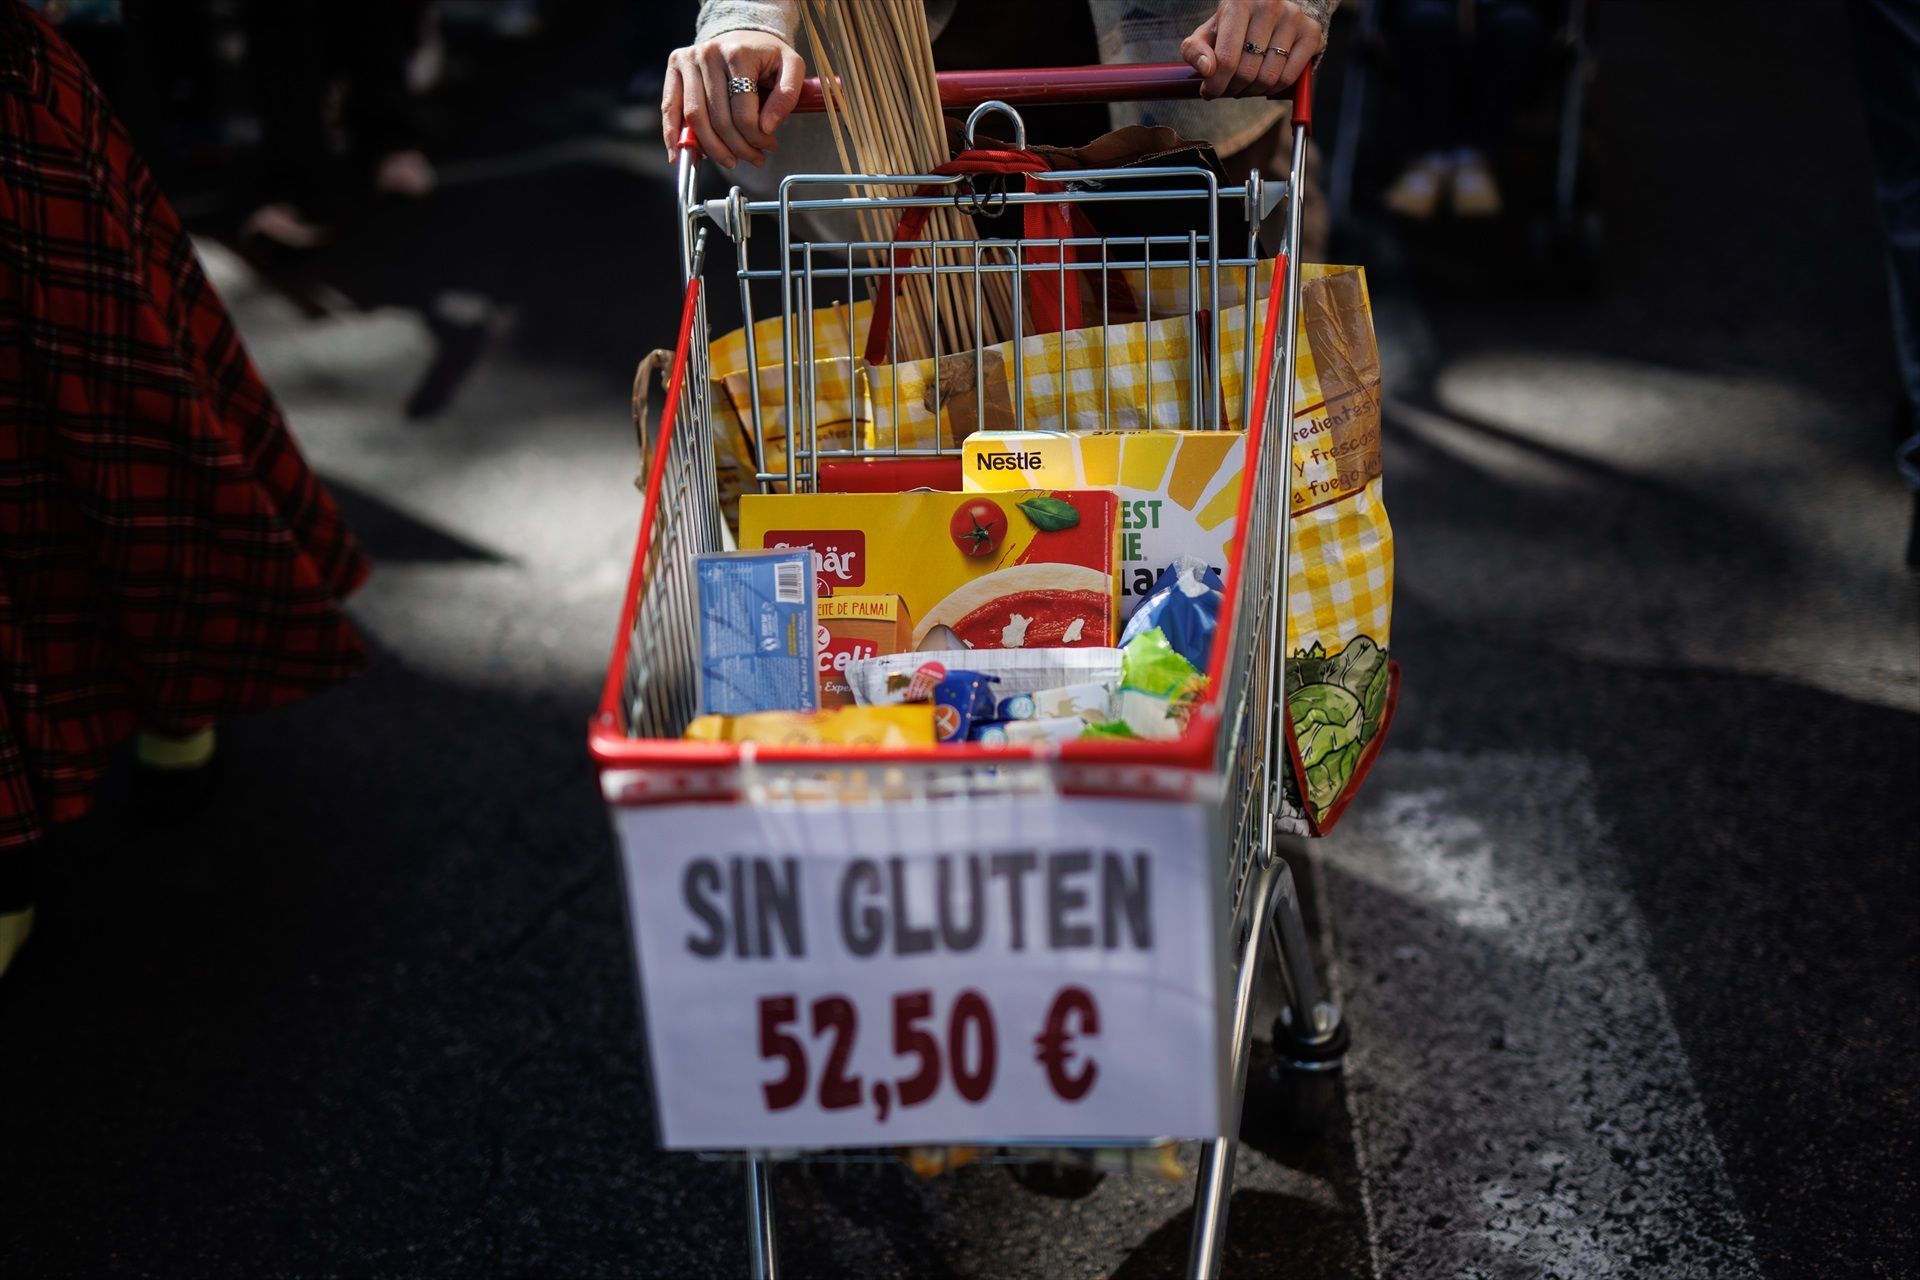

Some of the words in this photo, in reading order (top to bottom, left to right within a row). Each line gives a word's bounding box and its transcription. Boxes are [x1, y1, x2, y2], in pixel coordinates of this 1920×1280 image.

[1294, 460, 1305, 478] y
[1310, 428, 1376, 465] frescos
[1294, 491, 1306, 504] a
[1308, 469, 1360, 496] fuego
[837, 602, 849, 616] DE
[852, 602, 889, 617] PALMA!
[681, 854, 806, 960] SIN
[838, 848, 1156, 958] GLUTEN
[756, 988, 999, 1124] 52,50
[1033, 984, 1100, 1103] €
